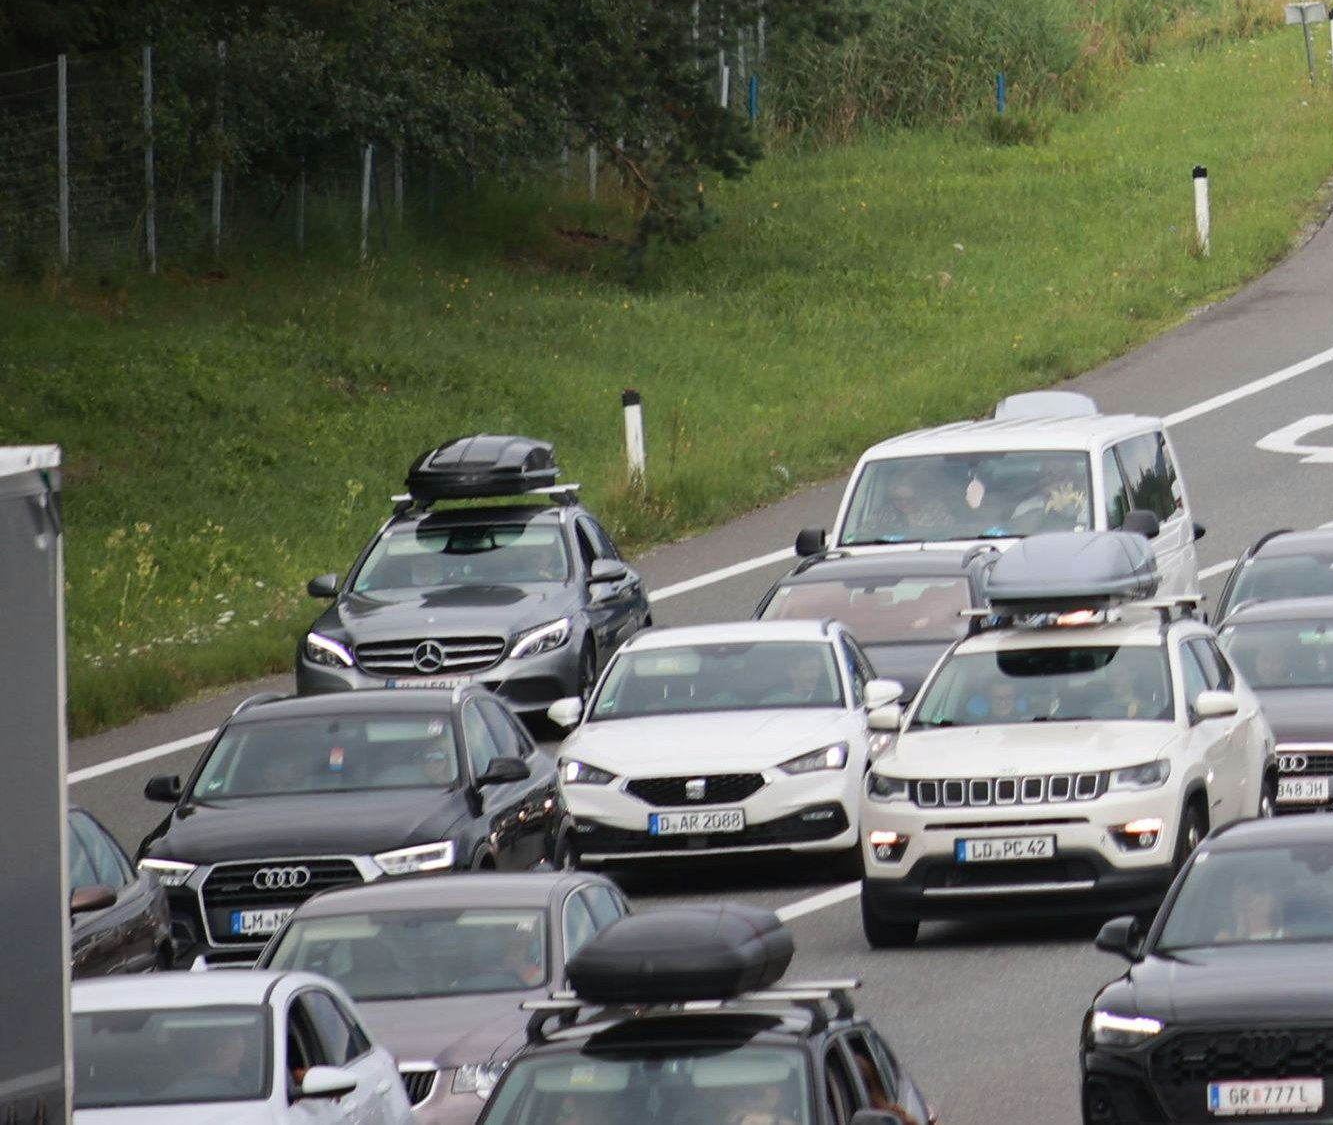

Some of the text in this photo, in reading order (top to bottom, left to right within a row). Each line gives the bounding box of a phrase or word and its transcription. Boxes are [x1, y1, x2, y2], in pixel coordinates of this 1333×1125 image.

[680, 815, 699, 830] AR
[703, 813, 740, 829] 2088
[1027, 839, 1046, 855] 42
[242, 914, 263, 930] LM
